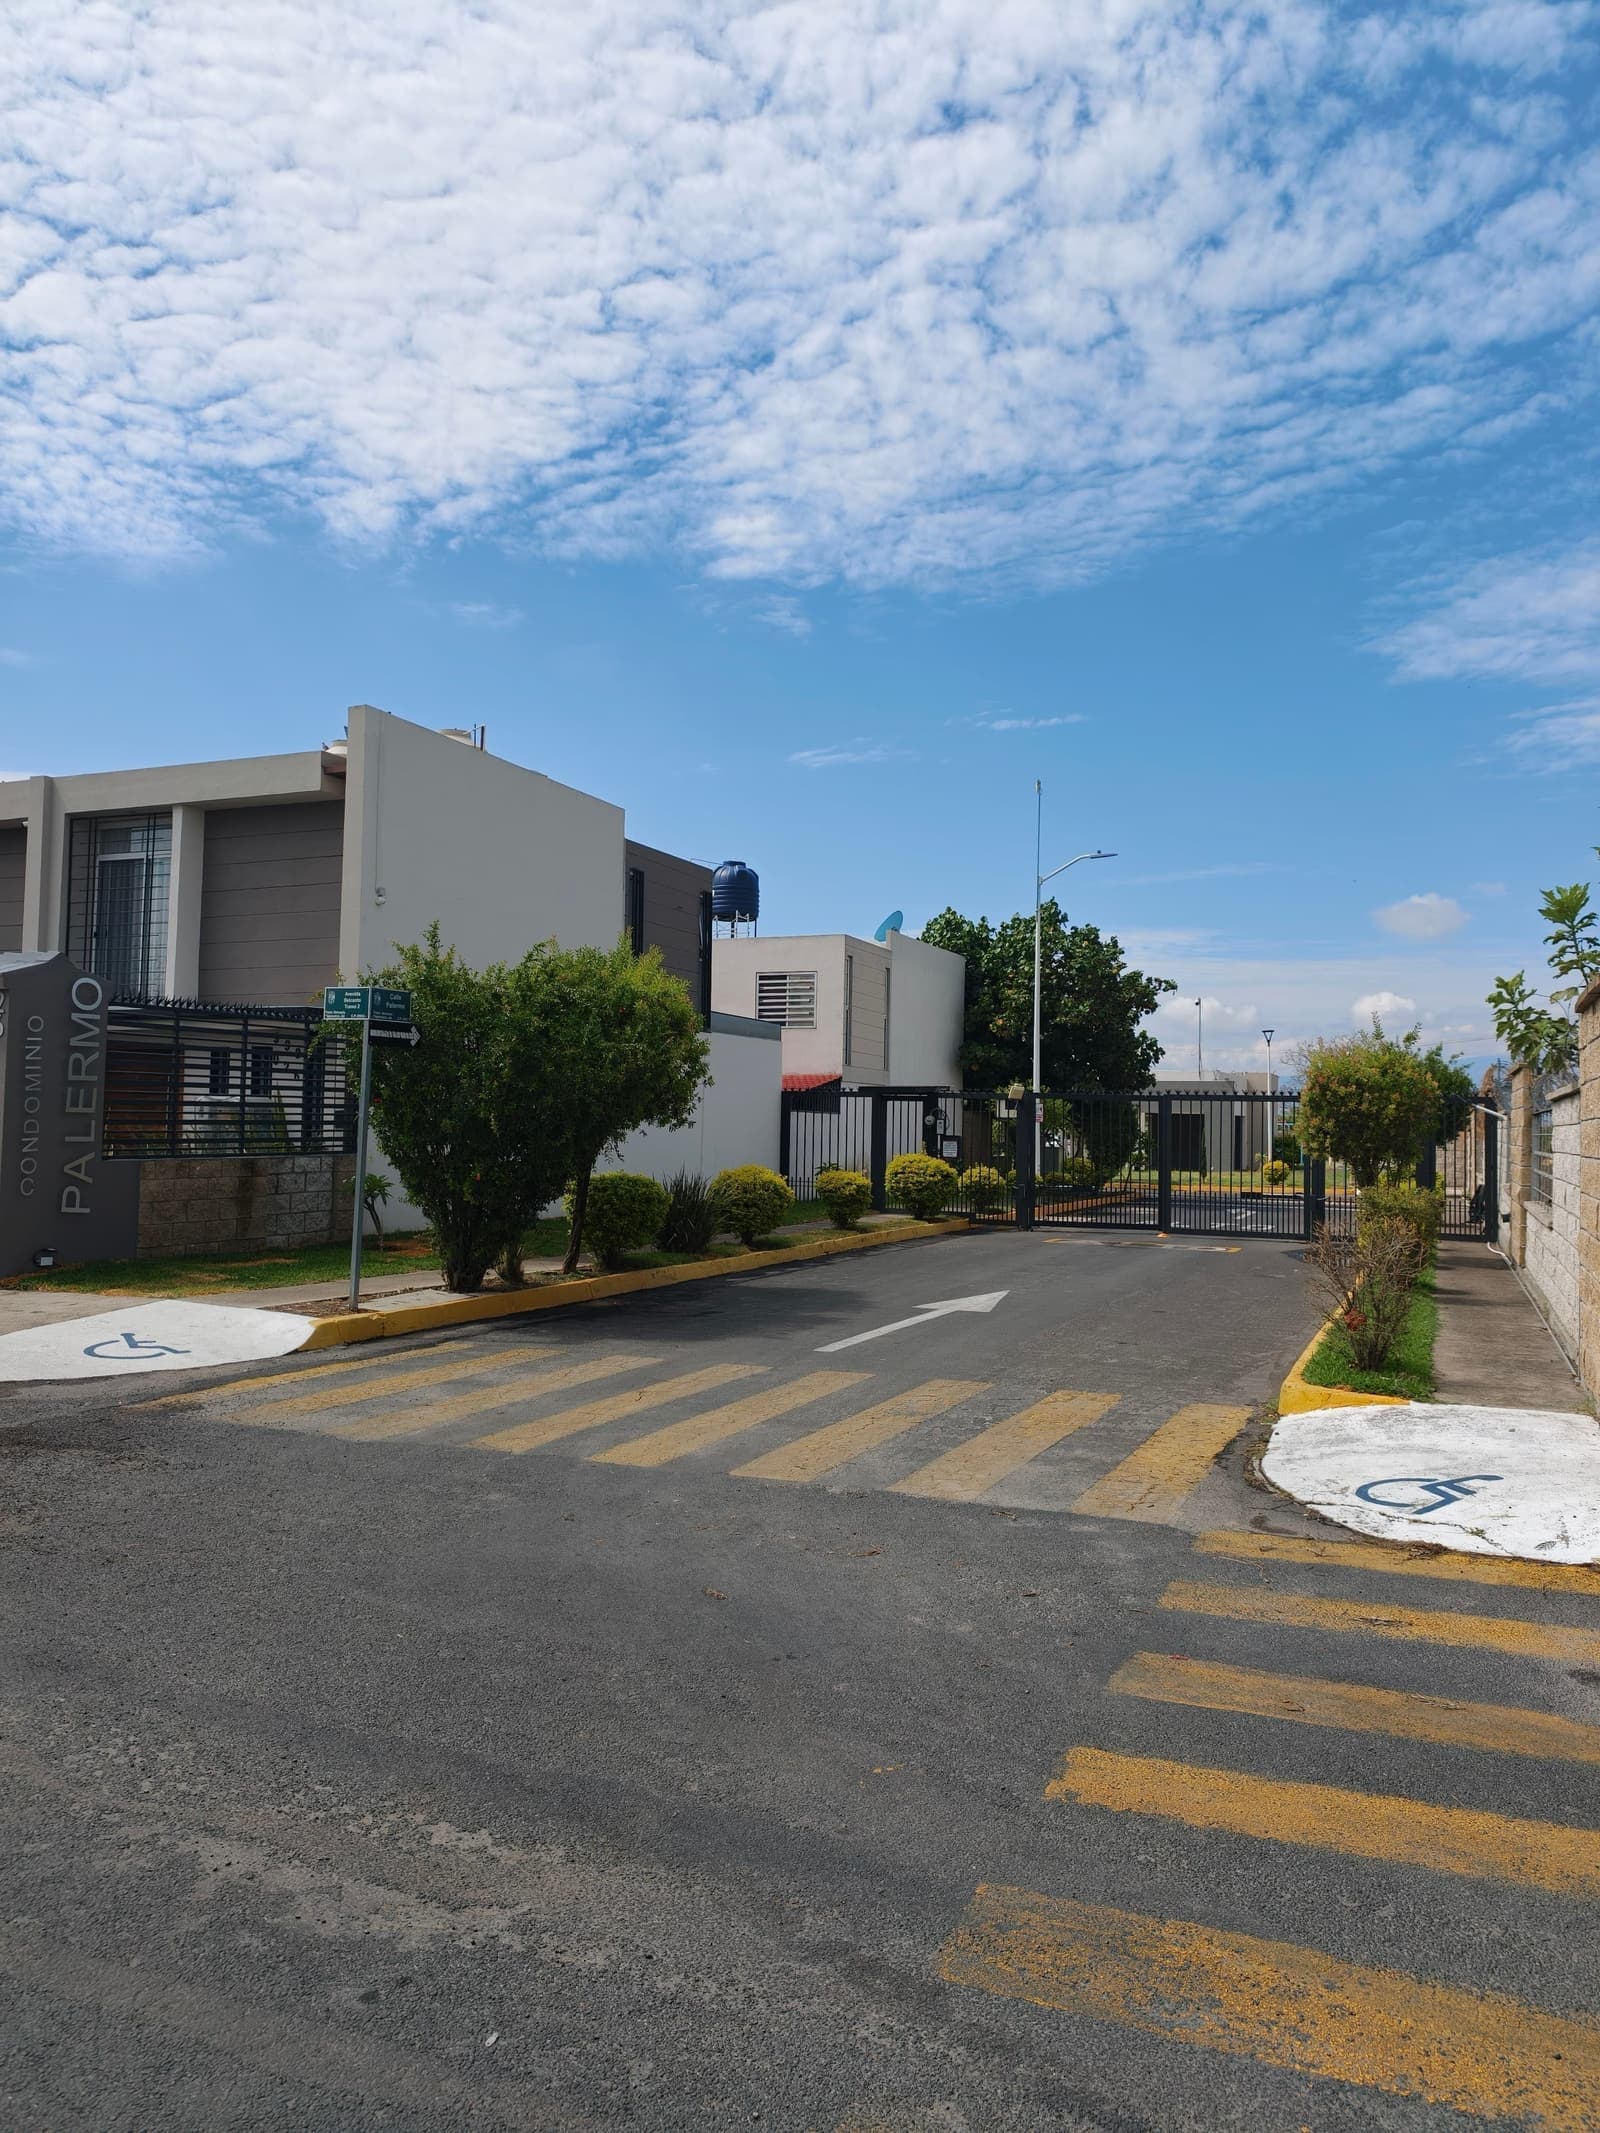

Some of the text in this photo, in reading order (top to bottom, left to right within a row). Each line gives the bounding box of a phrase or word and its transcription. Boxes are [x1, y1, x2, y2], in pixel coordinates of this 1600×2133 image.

[389, 993, 402, 1001] Calle
[20, 1015, 44, 1196] CONDOMINIO
[61, 977, 102, 1213] PALERMO
